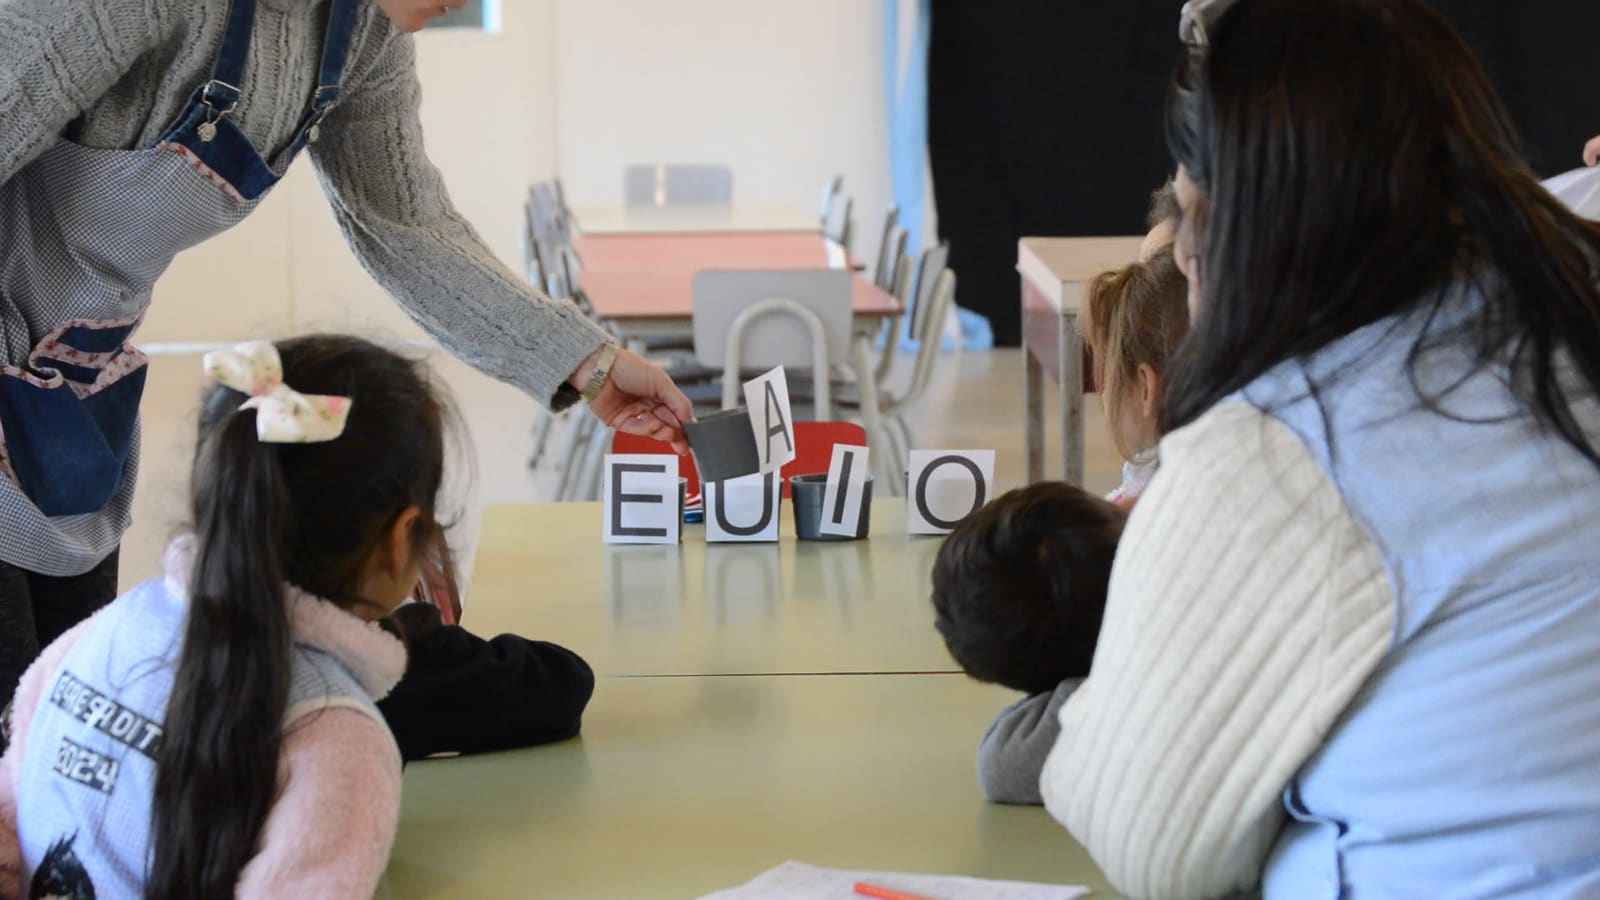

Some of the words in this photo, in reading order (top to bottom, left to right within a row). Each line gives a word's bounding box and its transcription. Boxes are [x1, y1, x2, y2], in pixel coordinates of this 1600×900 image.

[765, 380, 792, 463] A
[611, 463, 667, 536] E
[715, 472, 773, 536] U
[916, 455, 986, 530] O
